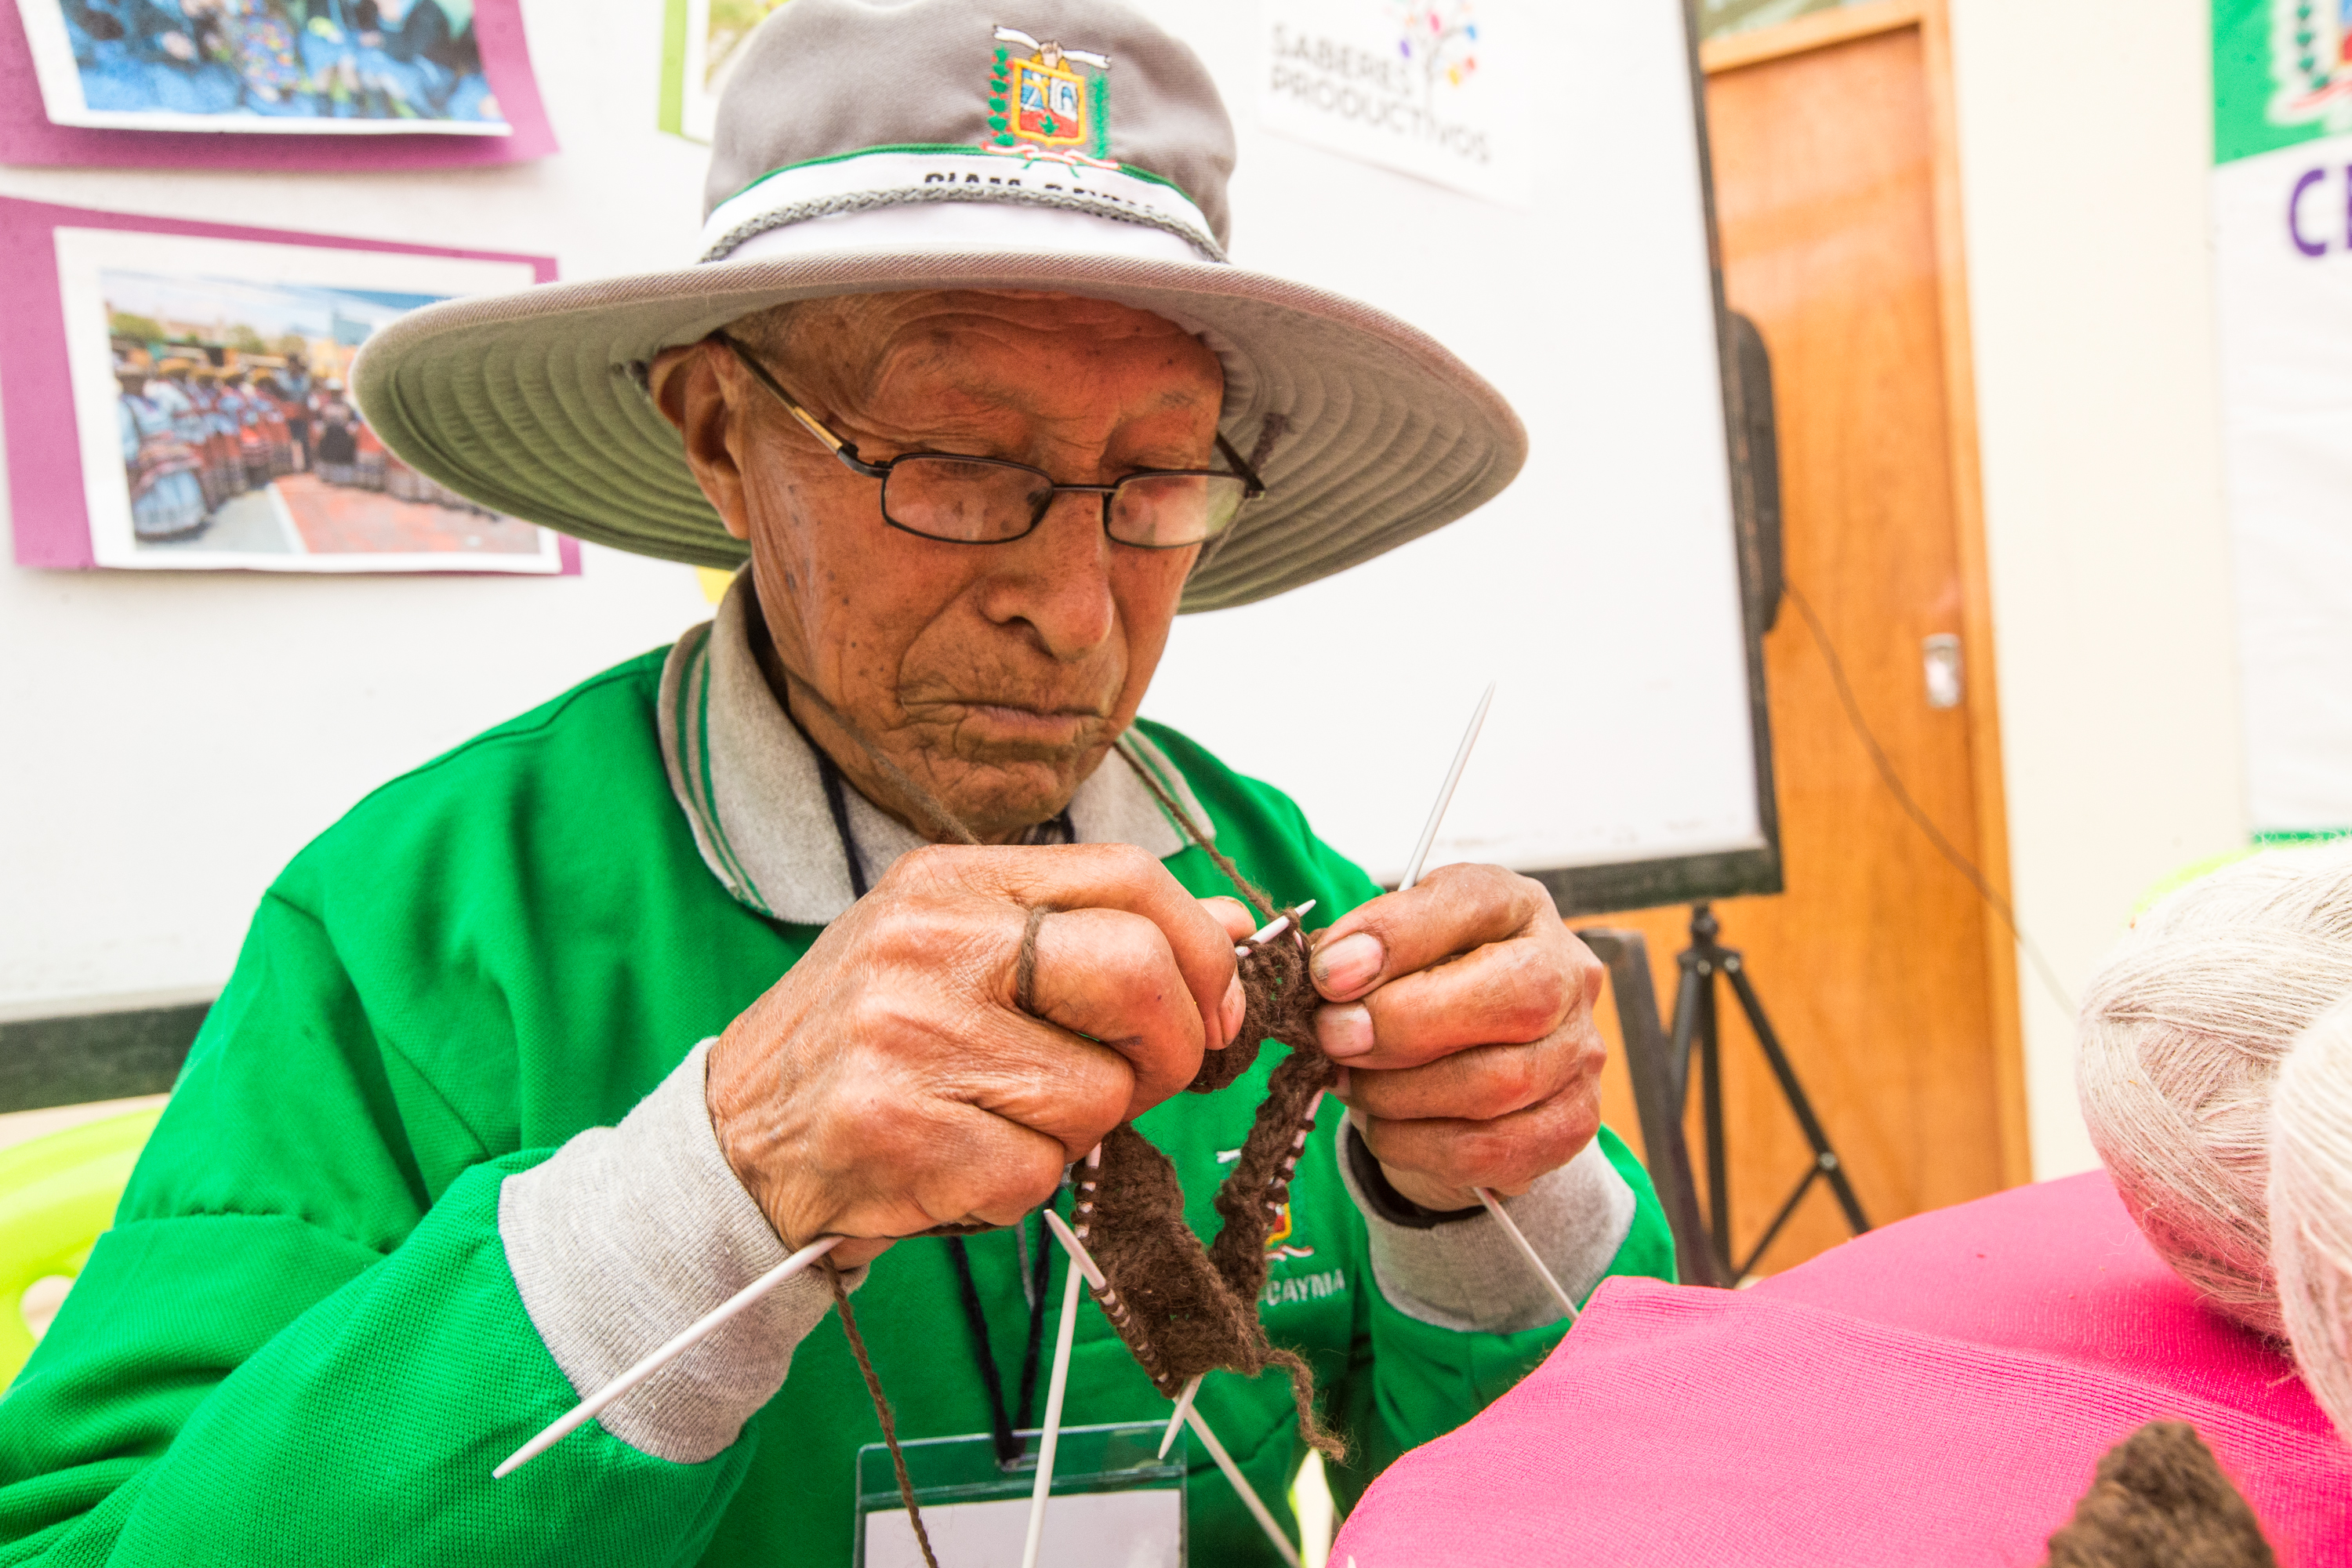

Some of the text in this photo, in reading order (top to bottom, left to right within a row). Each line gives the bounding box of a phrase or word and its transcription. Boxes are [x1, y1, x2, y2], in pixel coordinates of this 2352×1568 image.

[1272, 22, 1412, 97] SABERES
[1270, 64, 1490, 165] PRODUCTIVOS
[1266, 1268, 1346, 1306] CAYMA
